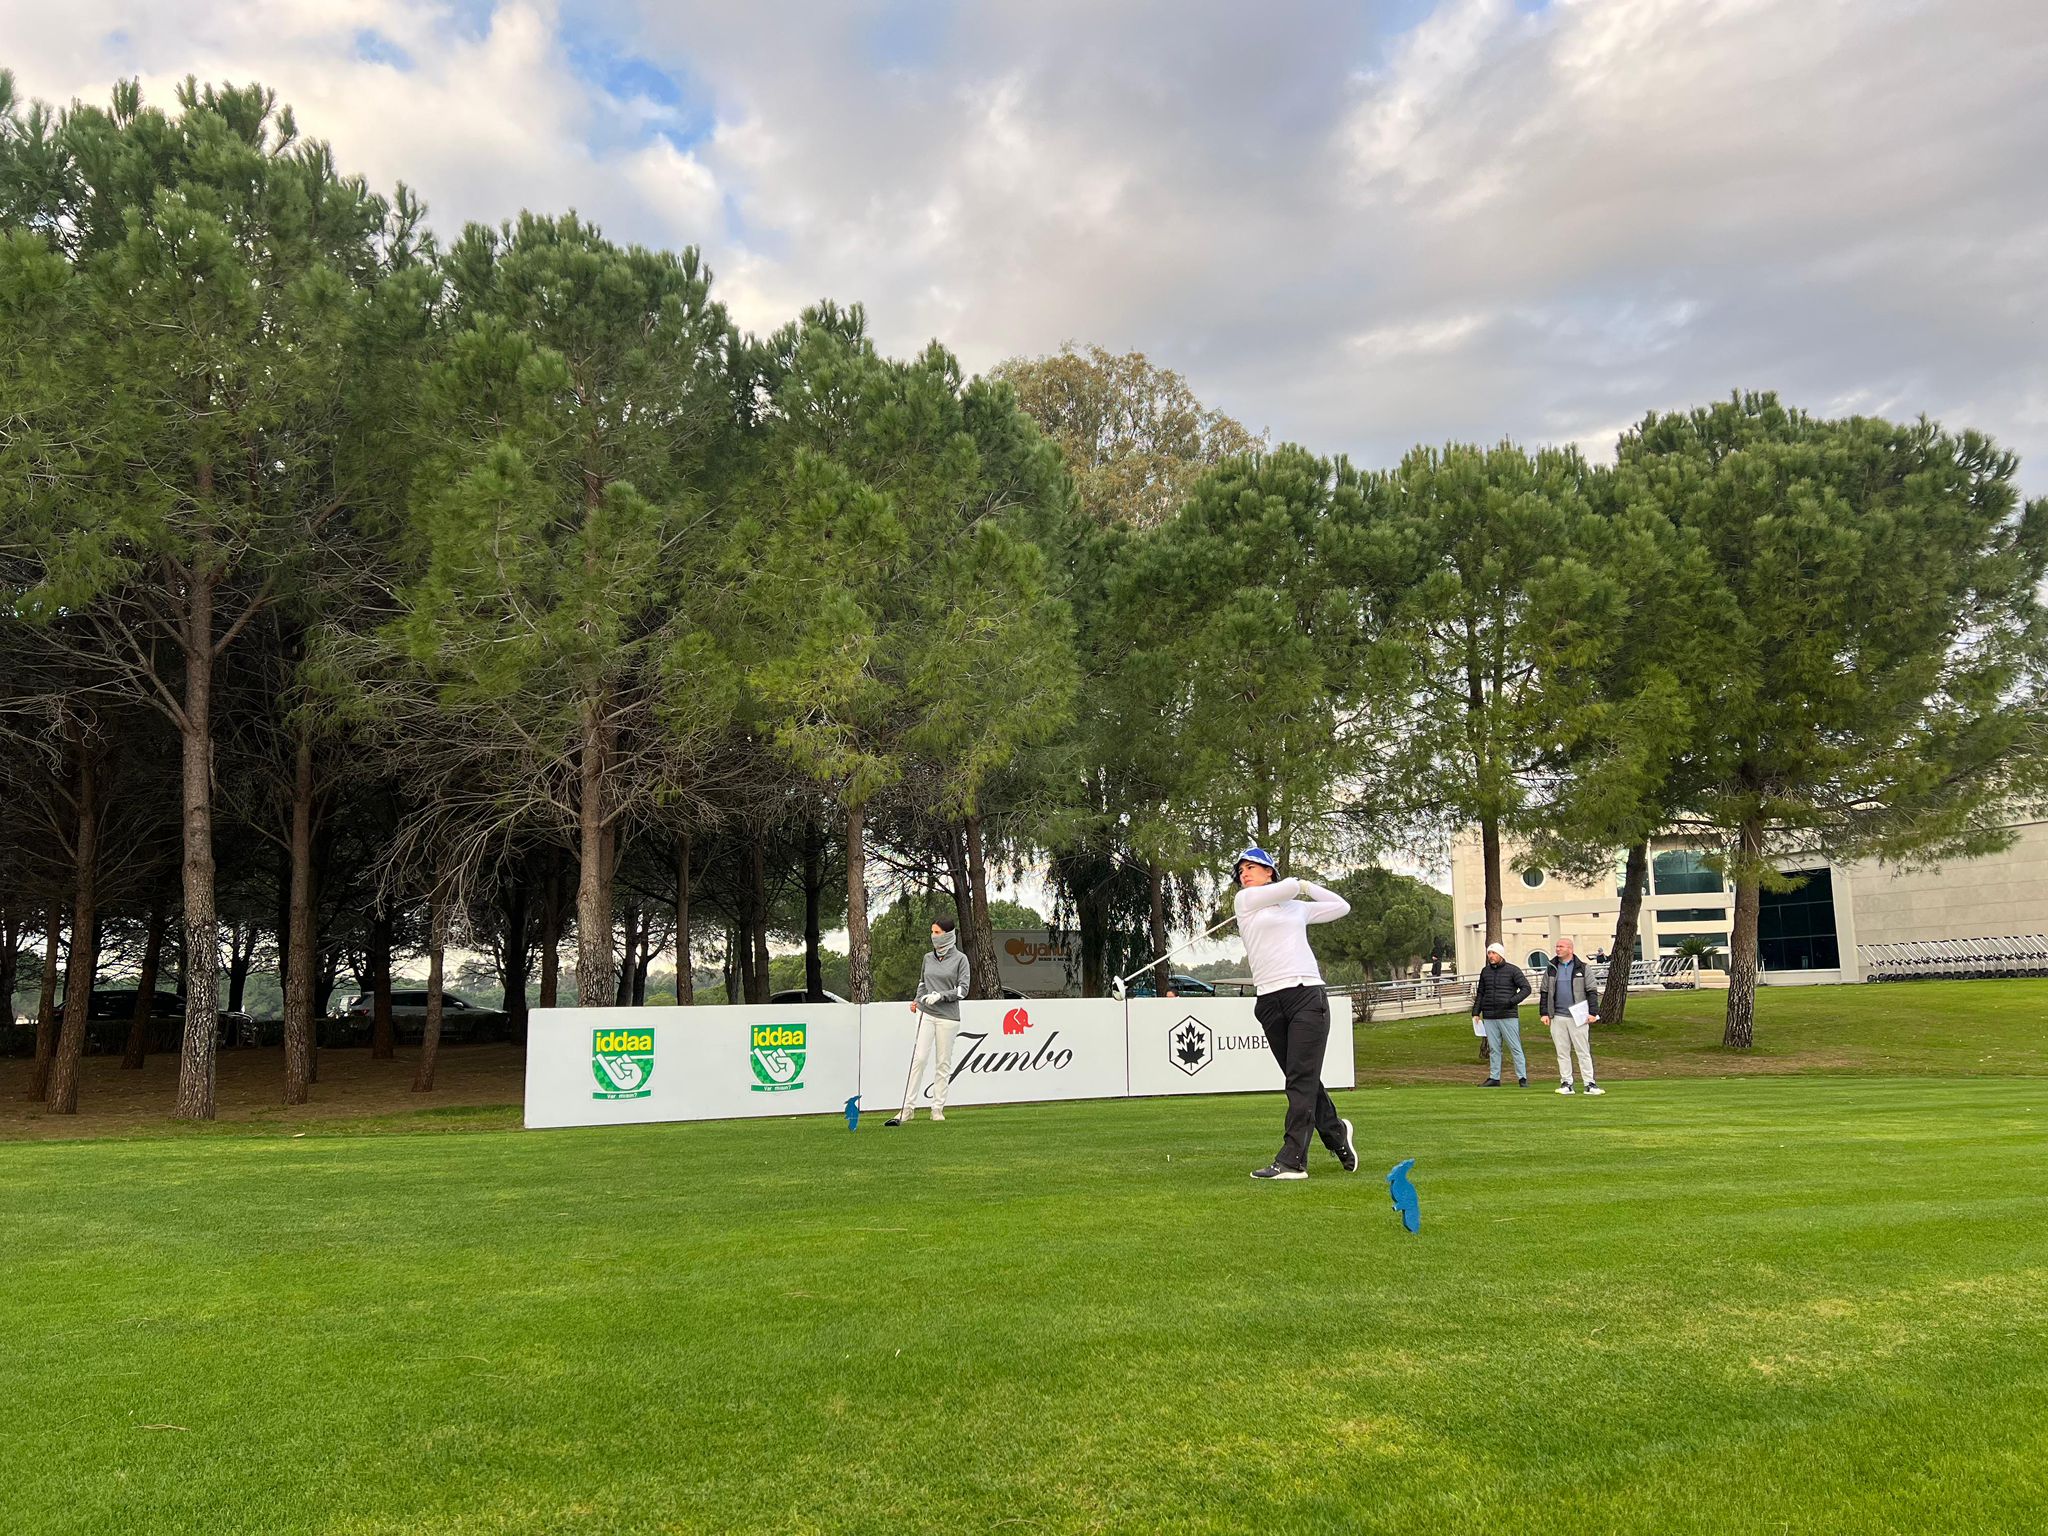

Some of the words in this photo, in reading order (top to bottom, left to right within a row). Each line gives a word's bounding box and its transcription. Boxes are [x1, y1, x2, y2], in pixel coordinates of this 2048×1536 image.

[595, 1031, 652, 1052] iddaa
[753, 1026, 804, 1047] iddaa
[1217, 1035, 1270, 1051] LUMBE
[923, 1031, 1073, 1099] Jumbo
